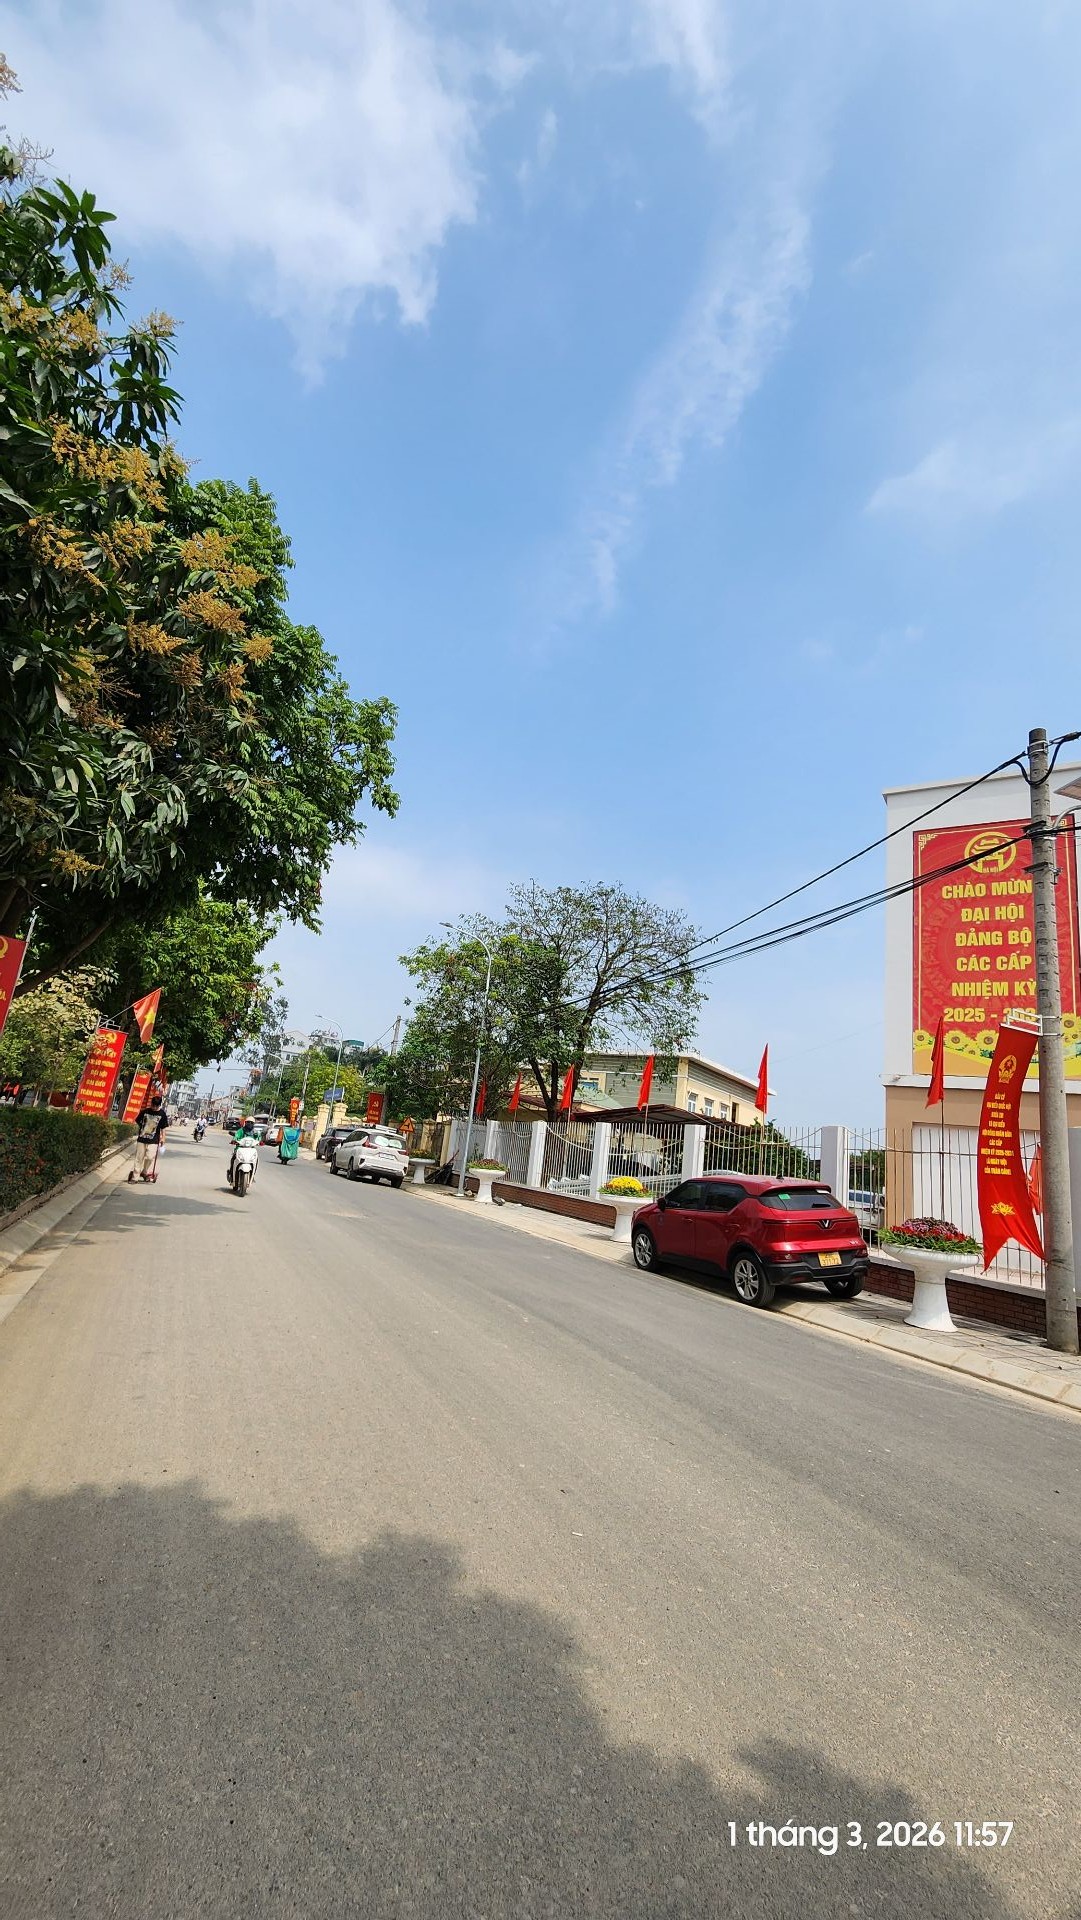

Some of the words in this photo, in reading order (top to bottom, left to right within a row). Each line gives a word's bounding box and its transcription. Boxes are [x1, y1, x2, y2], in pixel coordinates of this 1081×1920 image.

[942, 881, 986, 899] CHÀO
[991, 878, 1033, 896] MỪN
[961, 907, 990, 924] ĐẠI
[994, 902, 1024, 922] HỘI
[955, 927, 1003, 947] ĐẢNG
[1008, 926, 1032, 947] BỘ
[956, 954, 991, 971] CÁC
[996, 950, 1032, 971] CẤP
[951, 979, 1009, 999] NHIỆM
[1014, 978, 1037, 996] KỲ
[943, 1007, 986, 1023] 2025
[1002, 1007, 1037, 1022] 203
